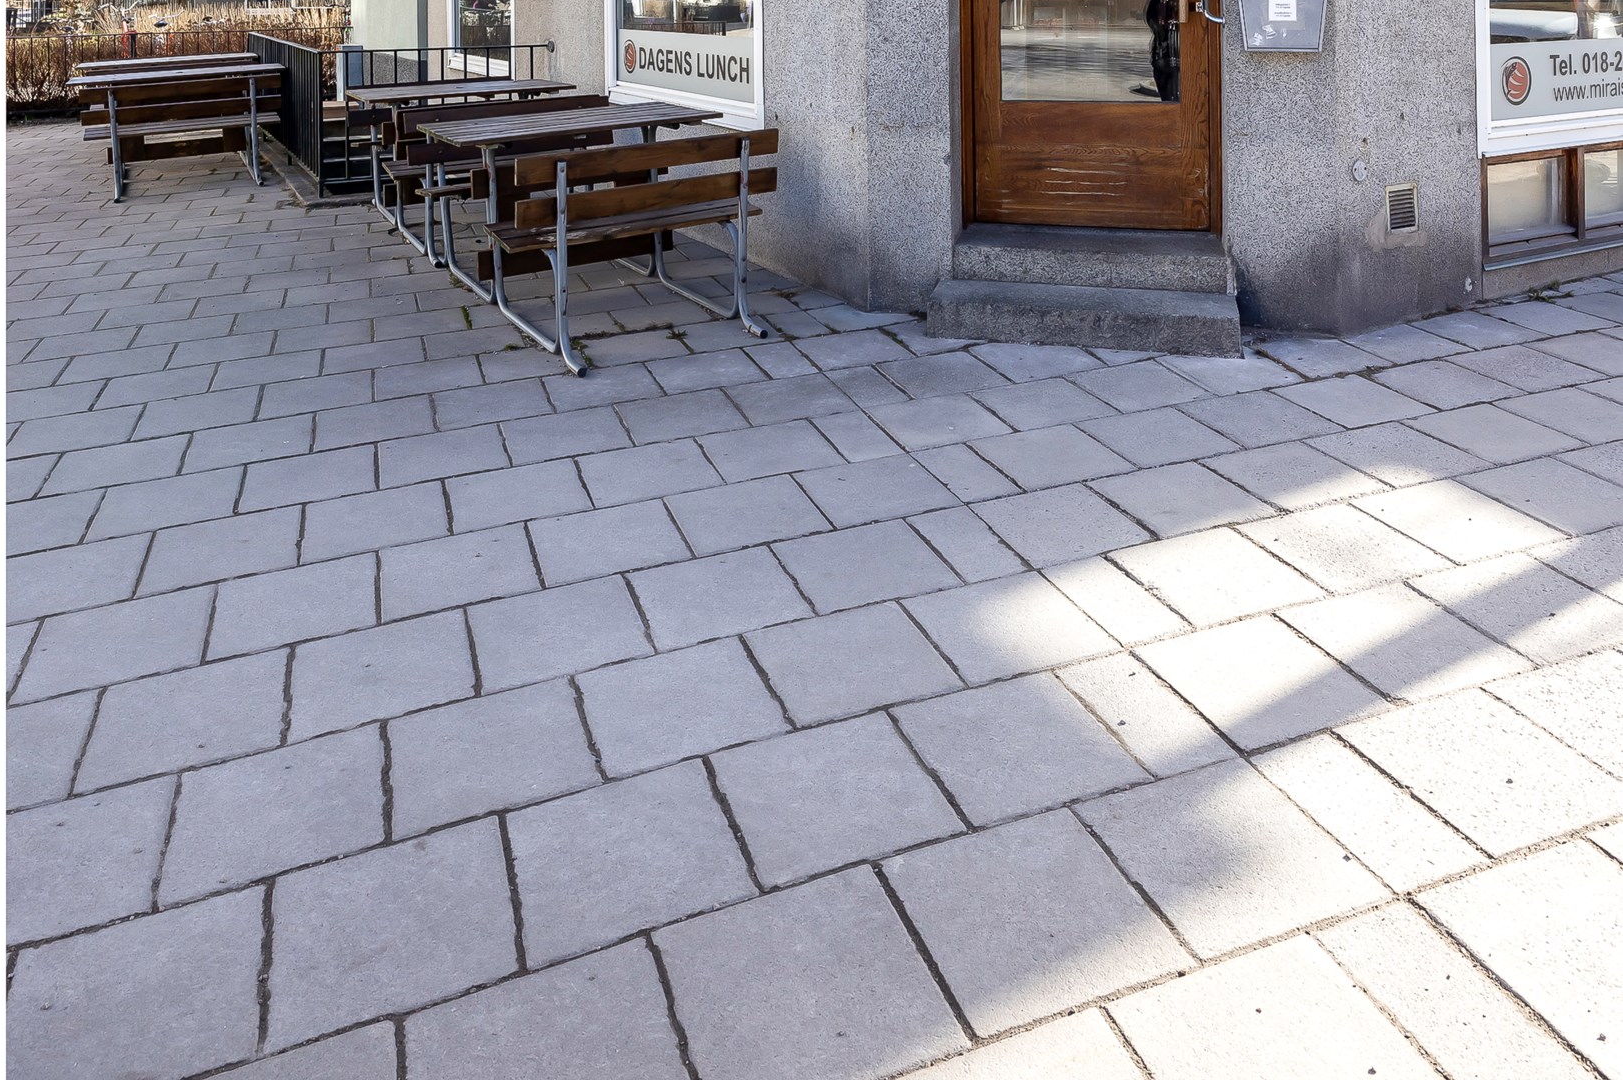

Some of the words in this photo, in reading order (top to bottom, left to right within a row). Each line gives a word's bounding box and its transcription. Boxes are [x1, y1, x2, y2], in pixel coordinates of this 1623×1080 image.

[639, 47, 693, 76] DAGENS
[697, 53, 750, 84] LUNCH
[1550, 53, 1577, 77] Tel.
[1582, 50, 1623, 74] 018-2
